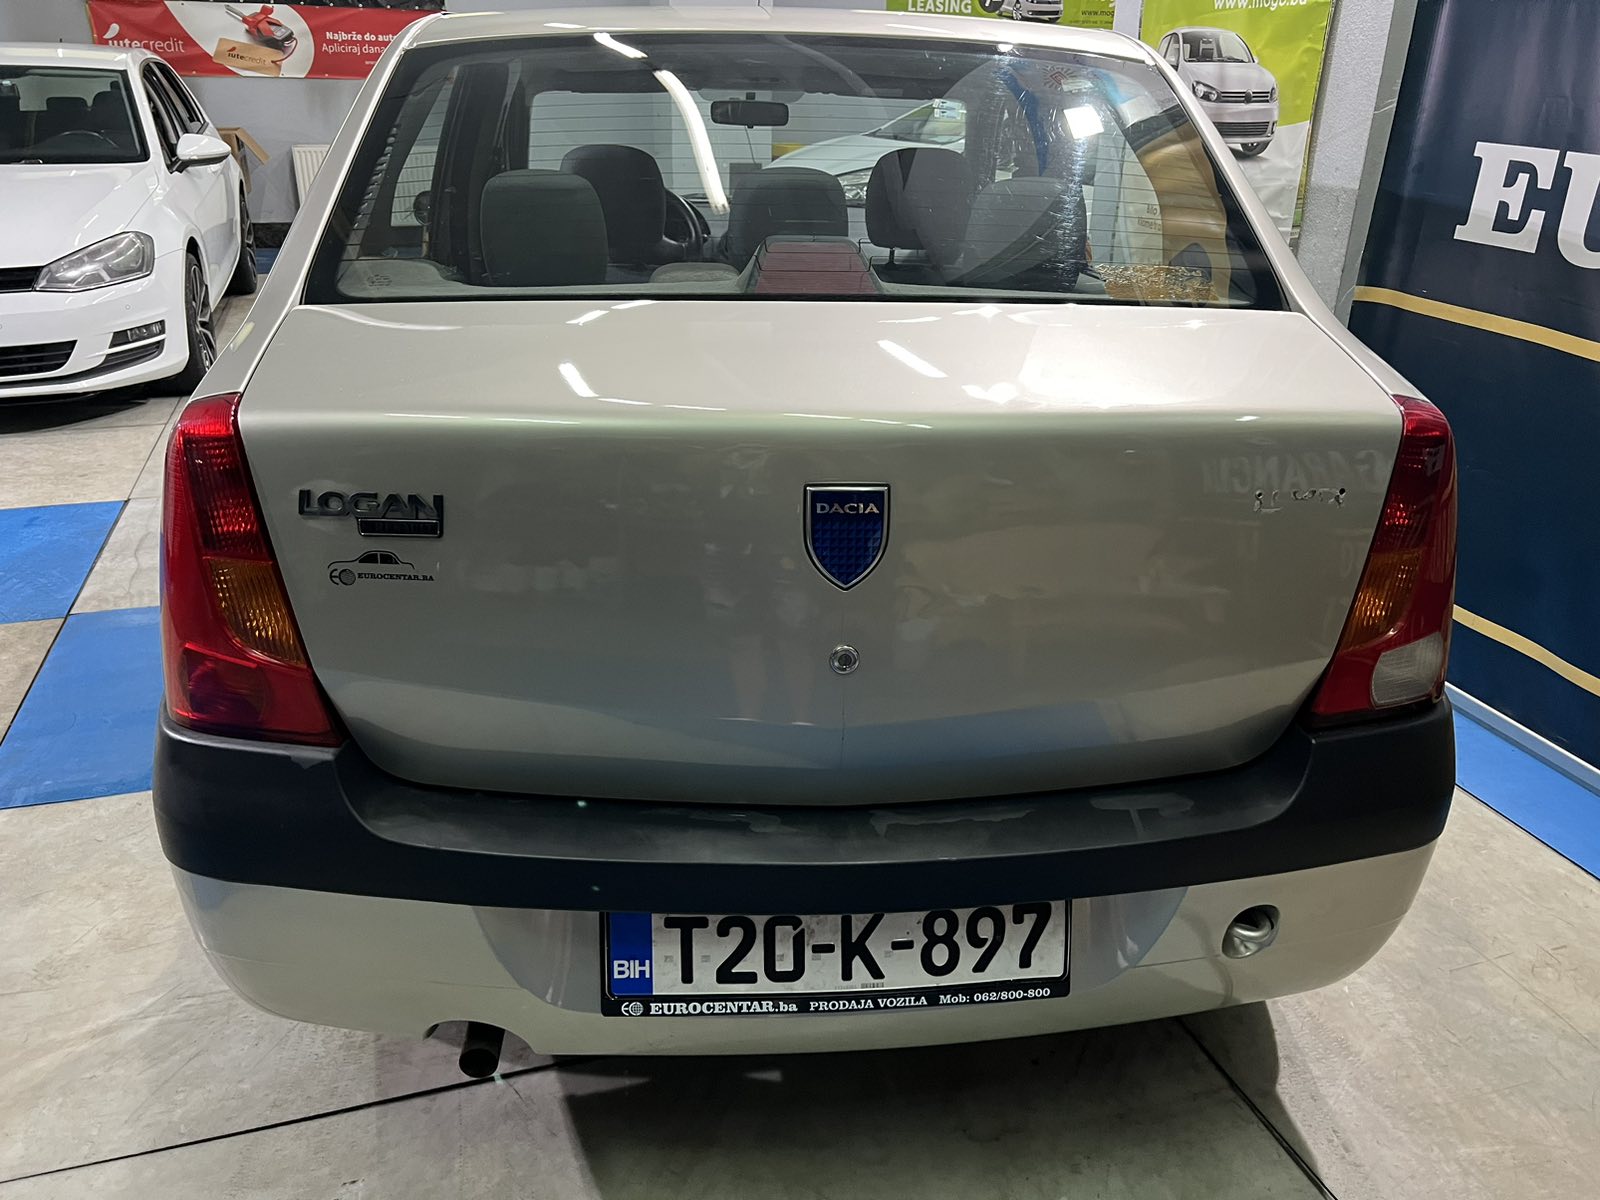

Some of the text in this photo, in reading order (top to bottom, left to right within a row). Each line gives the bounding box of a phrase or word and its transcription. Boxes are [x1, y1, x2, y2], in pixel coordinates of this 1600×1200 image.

[907, 0, 972, 14] LEASING
[325, 31, 362, 42] Najbrže
[364, 32, 376, 41] do
[321, 43, 361, 55] Apliciraj
[298, 489, 444, 518] LOGAN
[816, 502, 880, 514] DACIA
[663, 901, 1052, 985] T20-K-897
[613, 959, 651, 979] BIH
[650, 987, 1051, 1015] EUROCENTAR.ba PRODAJA VOZILA Mob: 062/800-800
